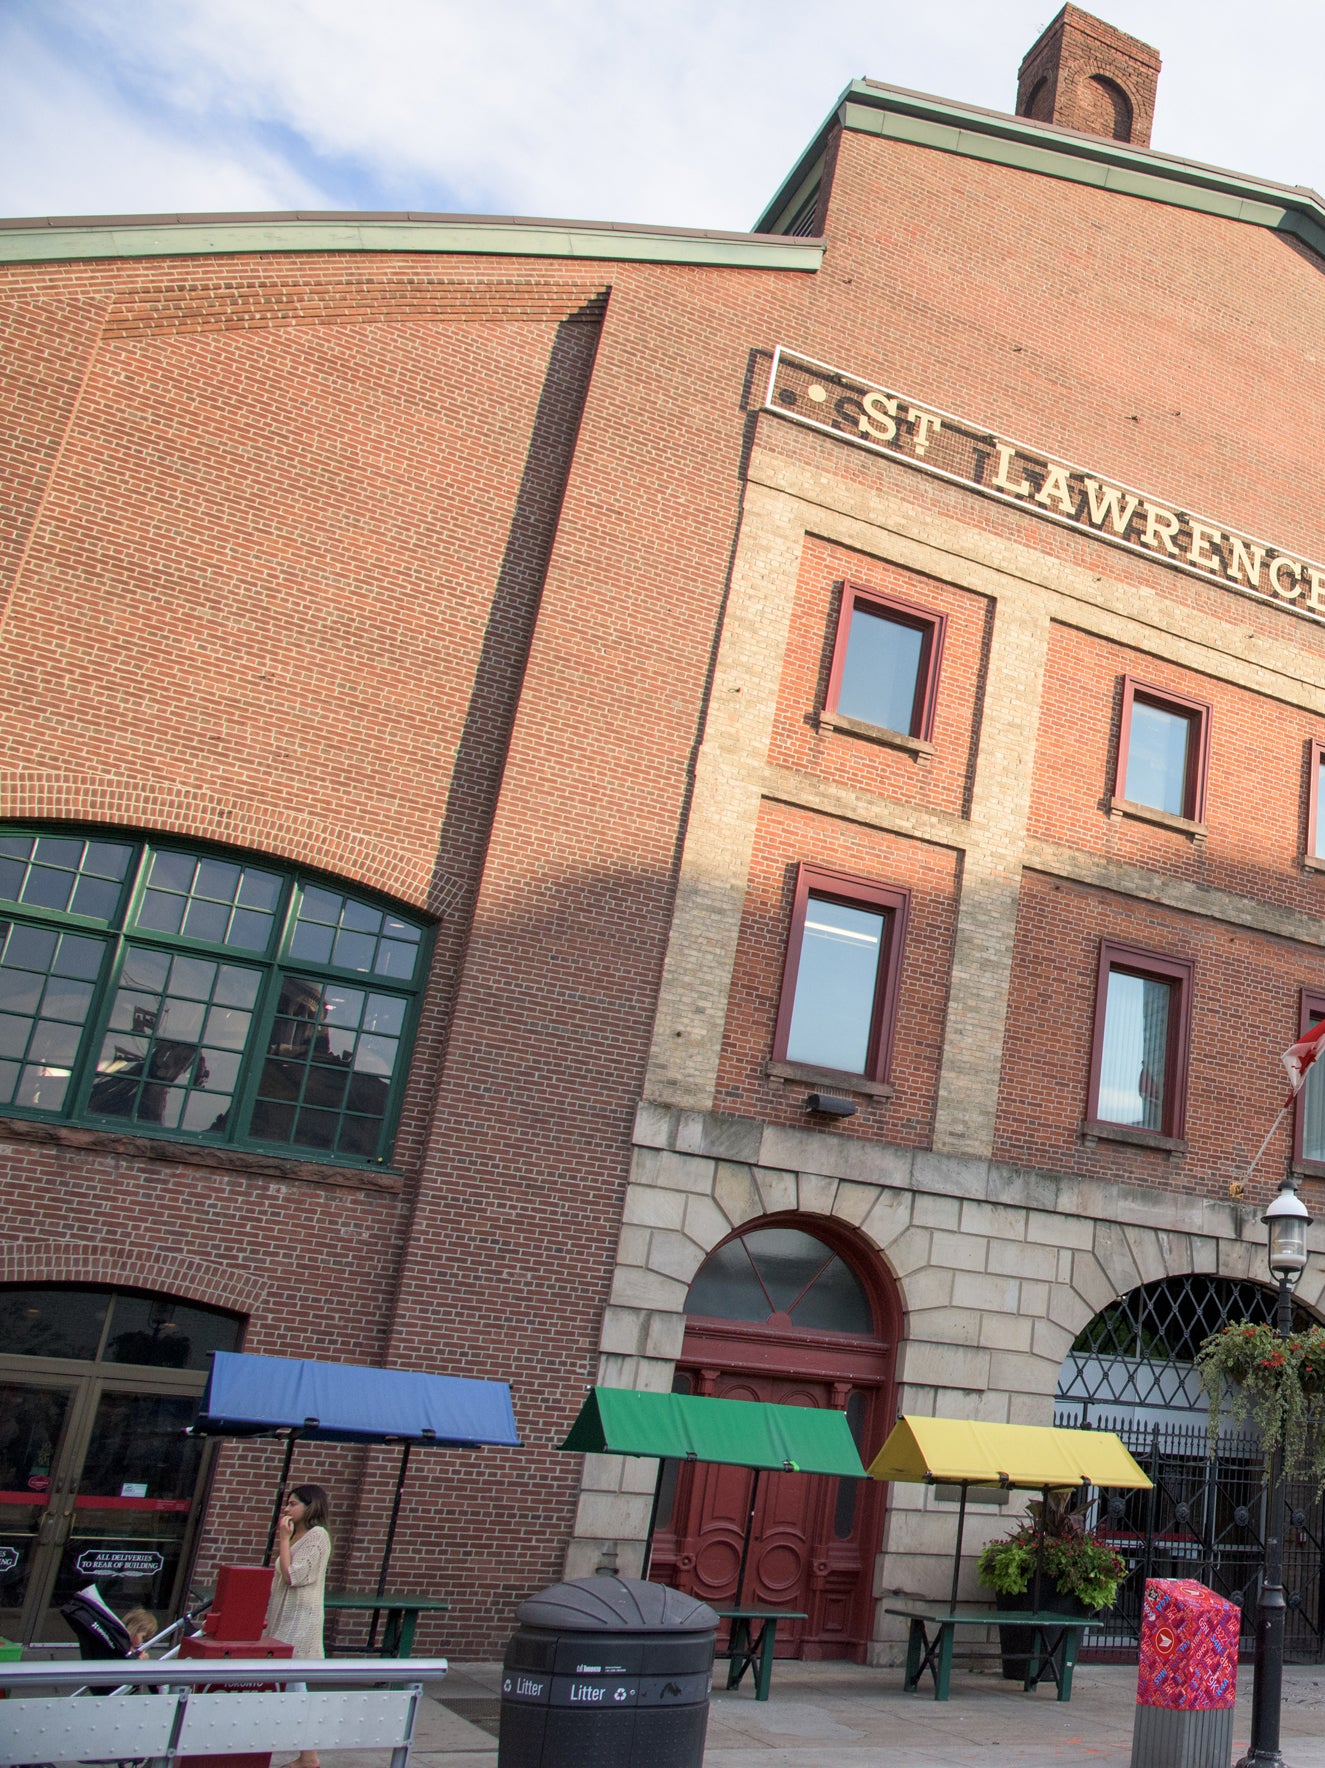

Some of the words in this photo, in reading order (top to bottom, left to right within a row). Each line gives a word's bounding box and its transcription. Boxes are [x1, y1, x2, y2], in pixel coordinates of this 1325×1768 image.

[111, 1554, 153, 1562] DELIVERIES
[516, 1677, 544, 1696] Litter
[570, 1684, 606, 1701] Litter
